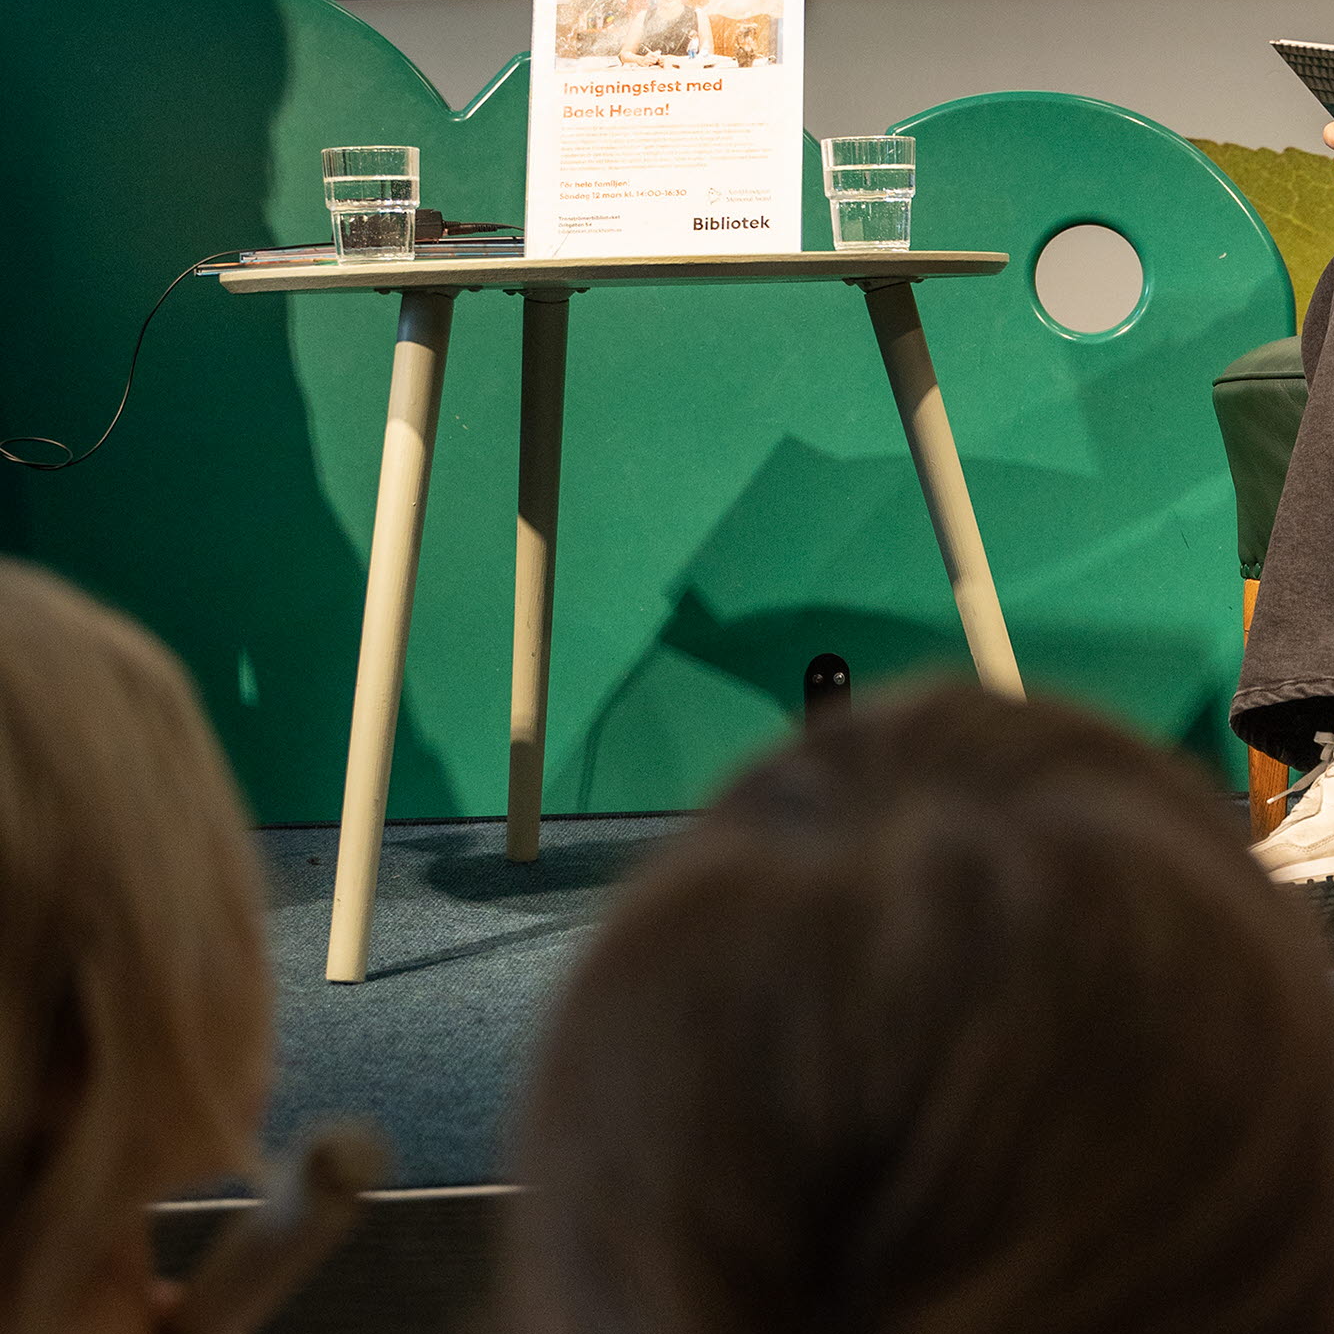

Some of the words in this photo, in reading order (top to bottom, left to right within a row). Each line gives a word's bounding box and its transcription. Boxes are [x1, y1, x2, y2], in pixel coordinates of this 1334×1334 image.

[563, 80, 681, 97] Invigningsfest
[686, 78, 723, 92] med
[563, 105, 604, 118] Baek
[609, 103, 670, 117] Heena!
[574, 180, 592, 188] hela
[592, 191, 601, 199] 12
[602, 190, 622, 199] mars
[636, 188, 687, 198] 14:00-16:30
[693, 215, 770, 231] Bibliotek
